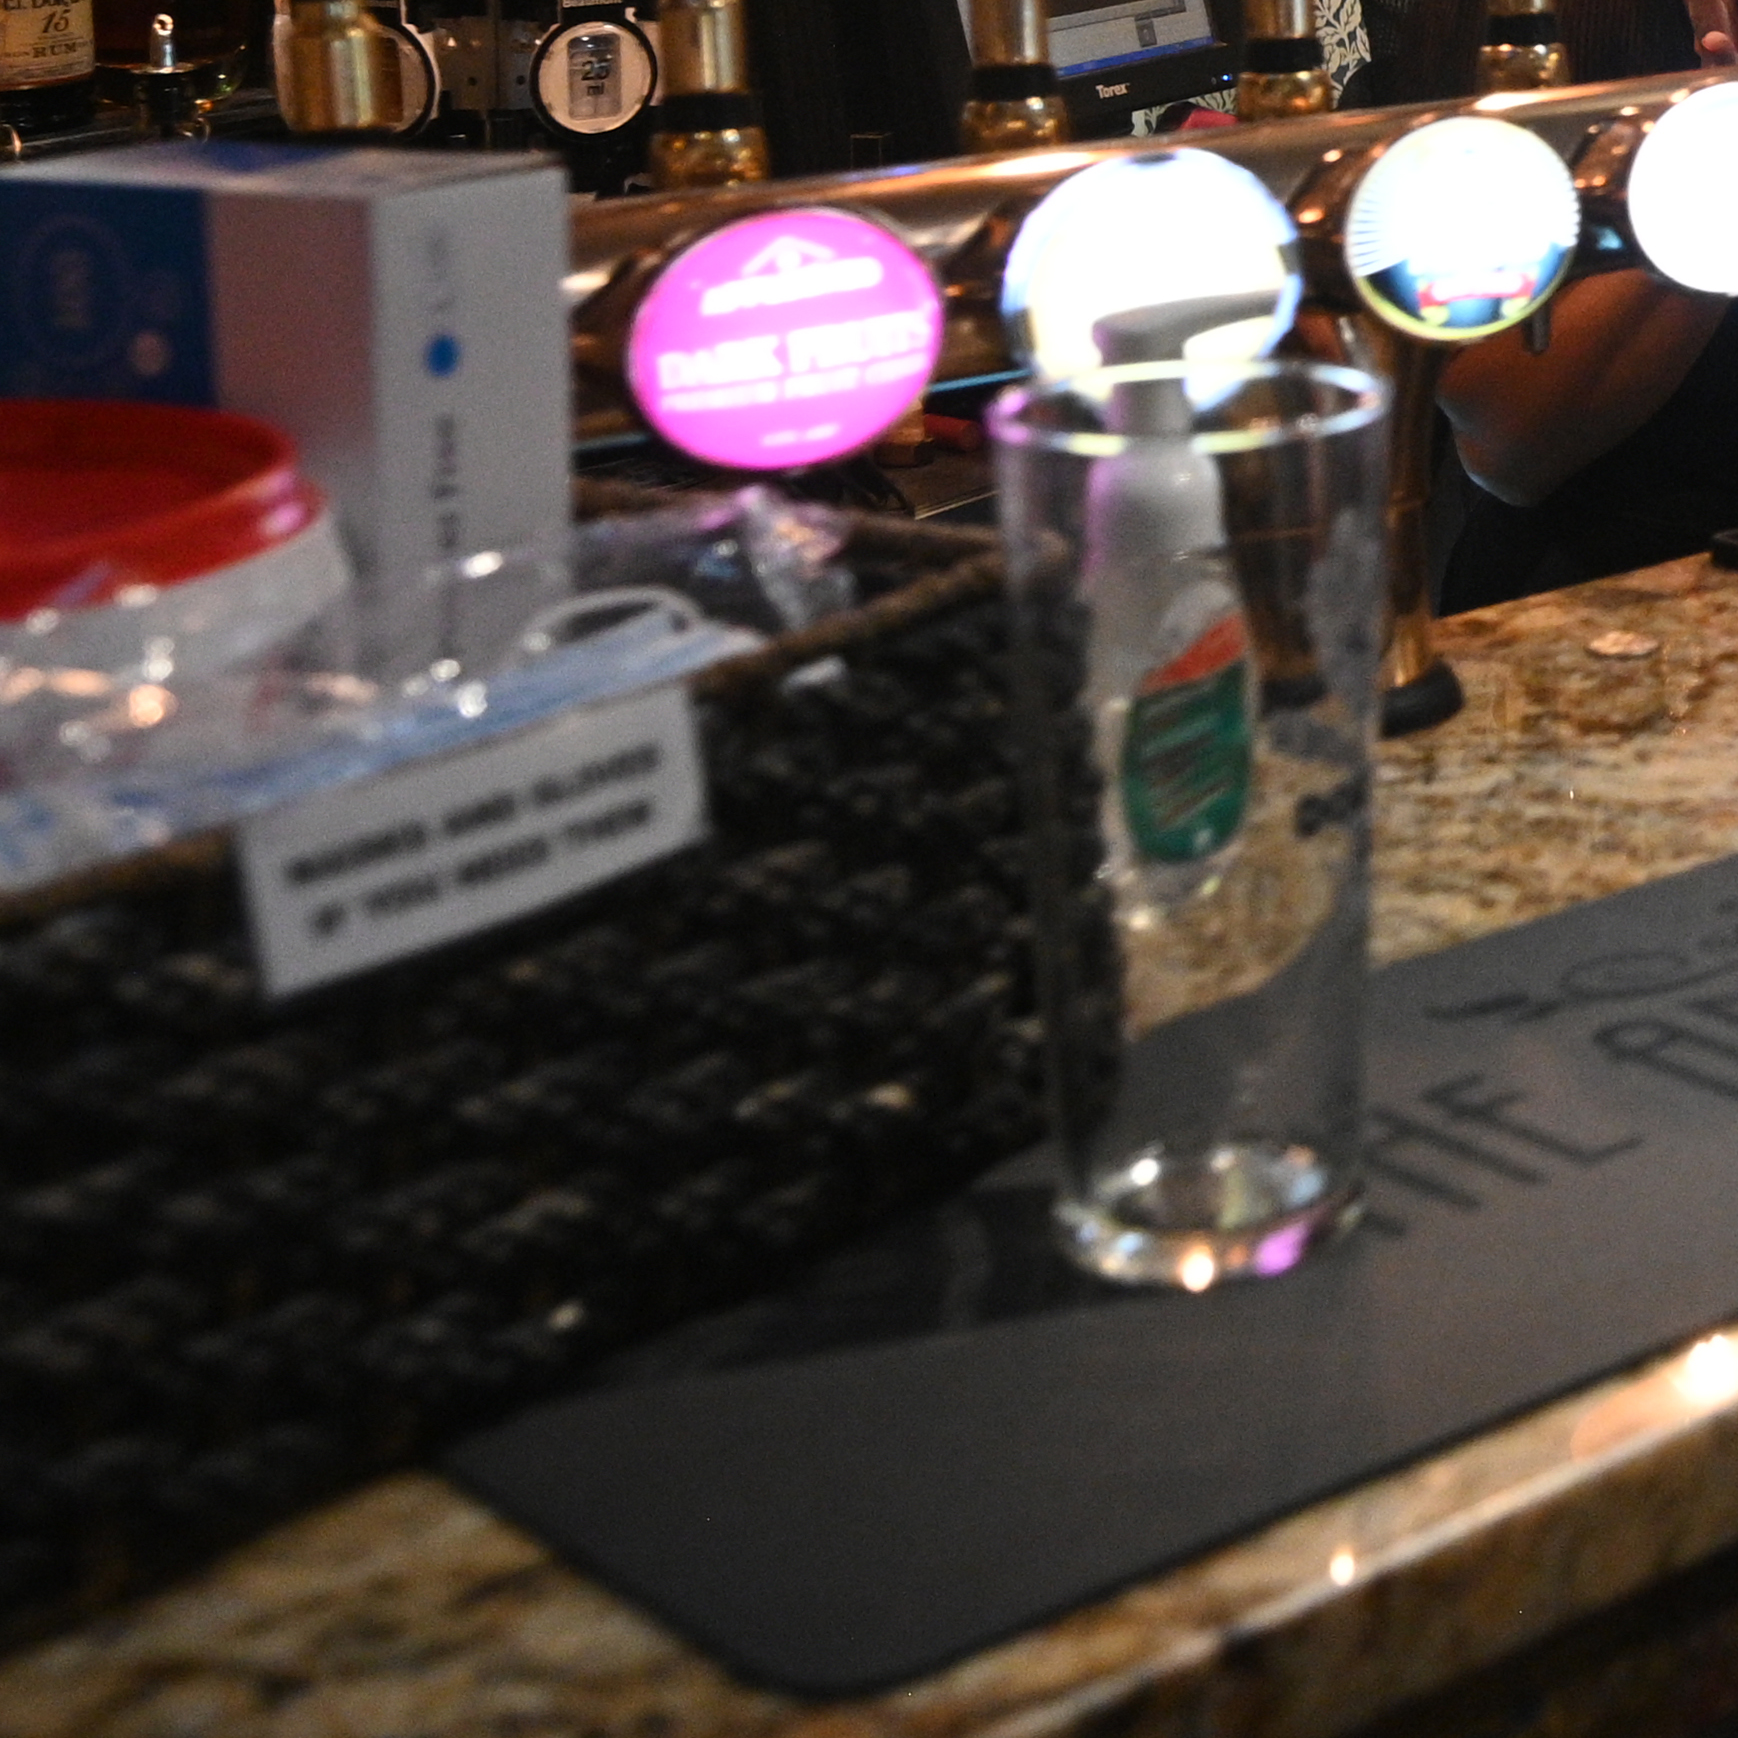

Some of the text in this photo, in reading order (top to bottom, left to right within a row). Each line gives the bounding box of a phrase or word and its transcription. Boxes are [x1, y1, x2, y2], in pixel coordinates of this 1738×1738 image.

[42, 9, 70, 34] 15
[33, 42, 77, 59] RUM
[1096, 82, 1129, 99] Torex
